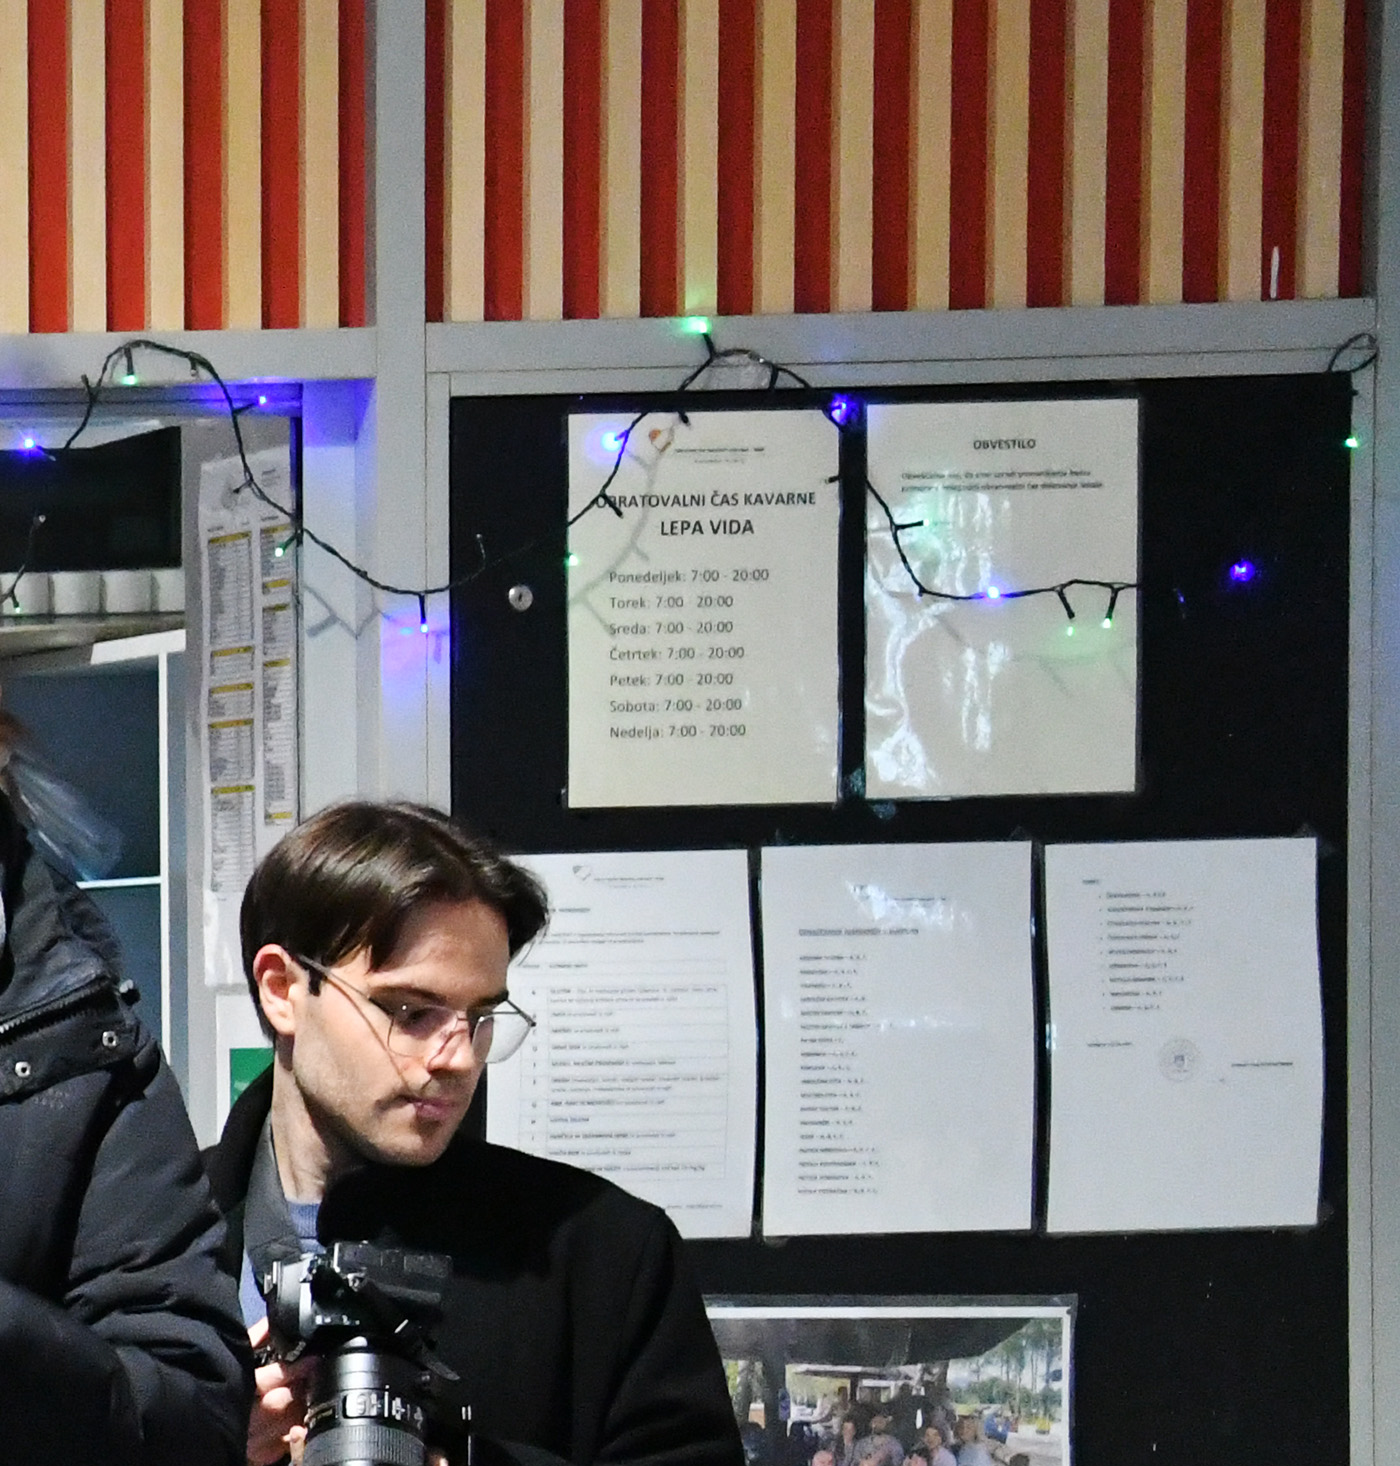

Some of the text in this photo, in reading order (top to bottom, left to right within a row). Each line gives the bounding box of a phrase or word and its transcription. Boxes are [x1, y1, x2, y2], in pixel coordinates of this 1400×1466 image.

[973, 439, 1037, 450] OBVESTILO
[711, 490, 739, 506] ČAS
[744, 492, 817, 506] KAVARNE
[660, 519, 755, 536] LEPA VIDA
[691, 569, 720, 582] 7:00
[732, 569, 770, 582] 20:00
[656, 596, 684, 608] 7:00
[697, 595, 734, 608] 20:00
[656, 621, 684, 634] 7:00
[697, 621, 734, 633] 20:00
[708, 646, 745, 659] 20:00
[656, 673, 684, 686] 7:00
[697, 673, 734, 685] 20:00
[665, 699, 693, 712] 7:00
[706, 698, 742, 711] 20:00
[669, 725, 697, 737] 7:00
